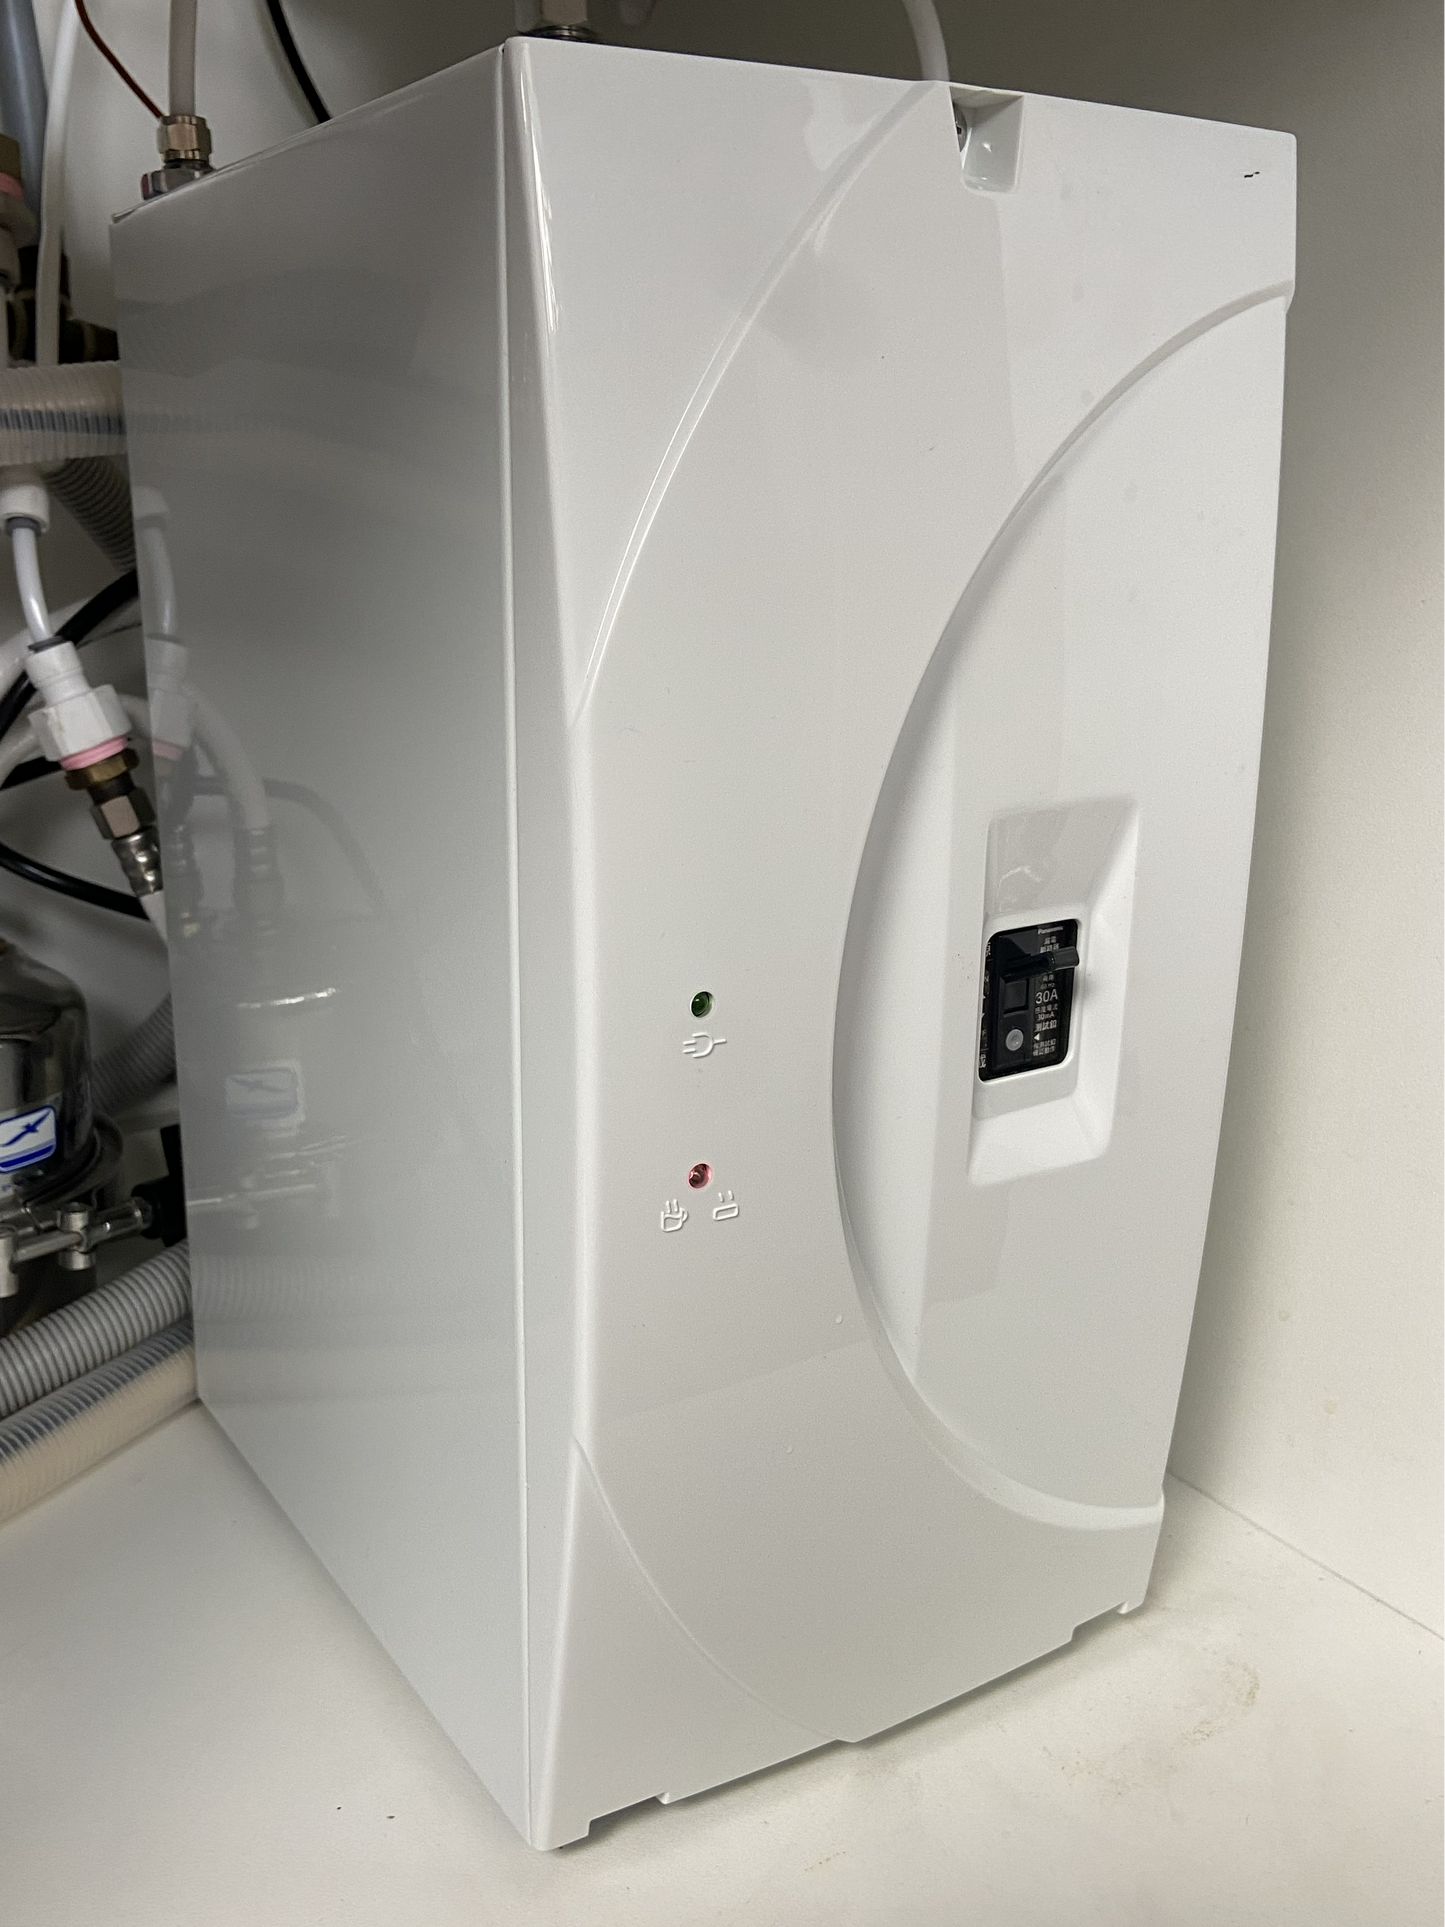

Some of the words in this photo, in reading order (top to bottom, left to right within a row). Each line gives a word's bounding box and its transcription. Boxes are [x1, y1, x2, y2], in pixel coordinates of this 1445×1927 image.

[1038, 926, 1063, 934] Panasonic
[1035, 988, 1058, 1004] 30A
[1037, 1011, 1055, 1021] 30mA
